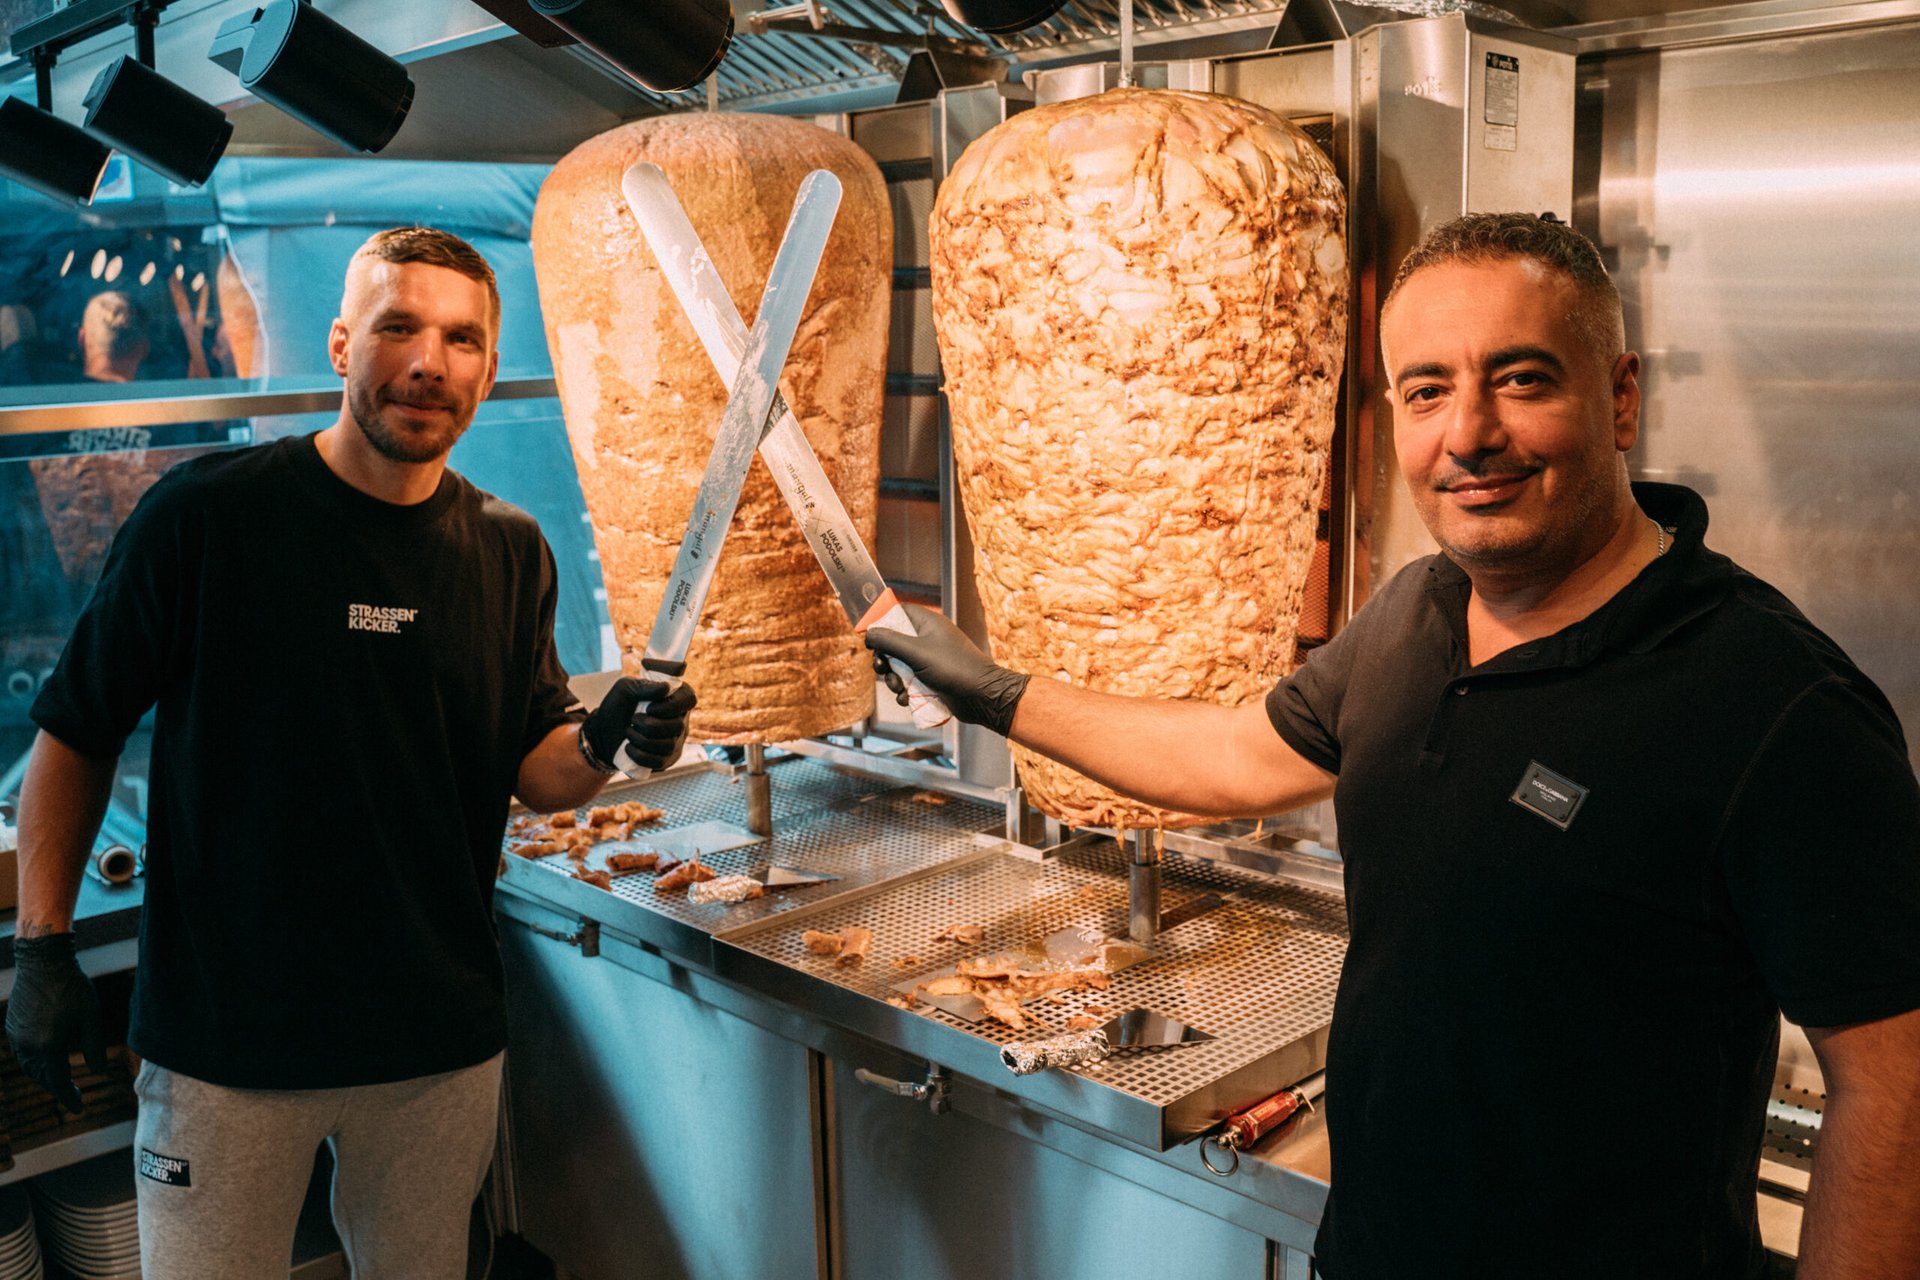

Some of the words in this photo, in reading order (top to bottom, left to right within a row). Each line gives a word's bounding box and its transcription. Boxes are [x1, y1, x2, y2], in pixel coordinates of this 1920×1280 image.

[827, 529, 843, 552] LUKAS
[680, 583, 692, 606] LUKAS
[348, 604, 415, 622] STRASSEN
